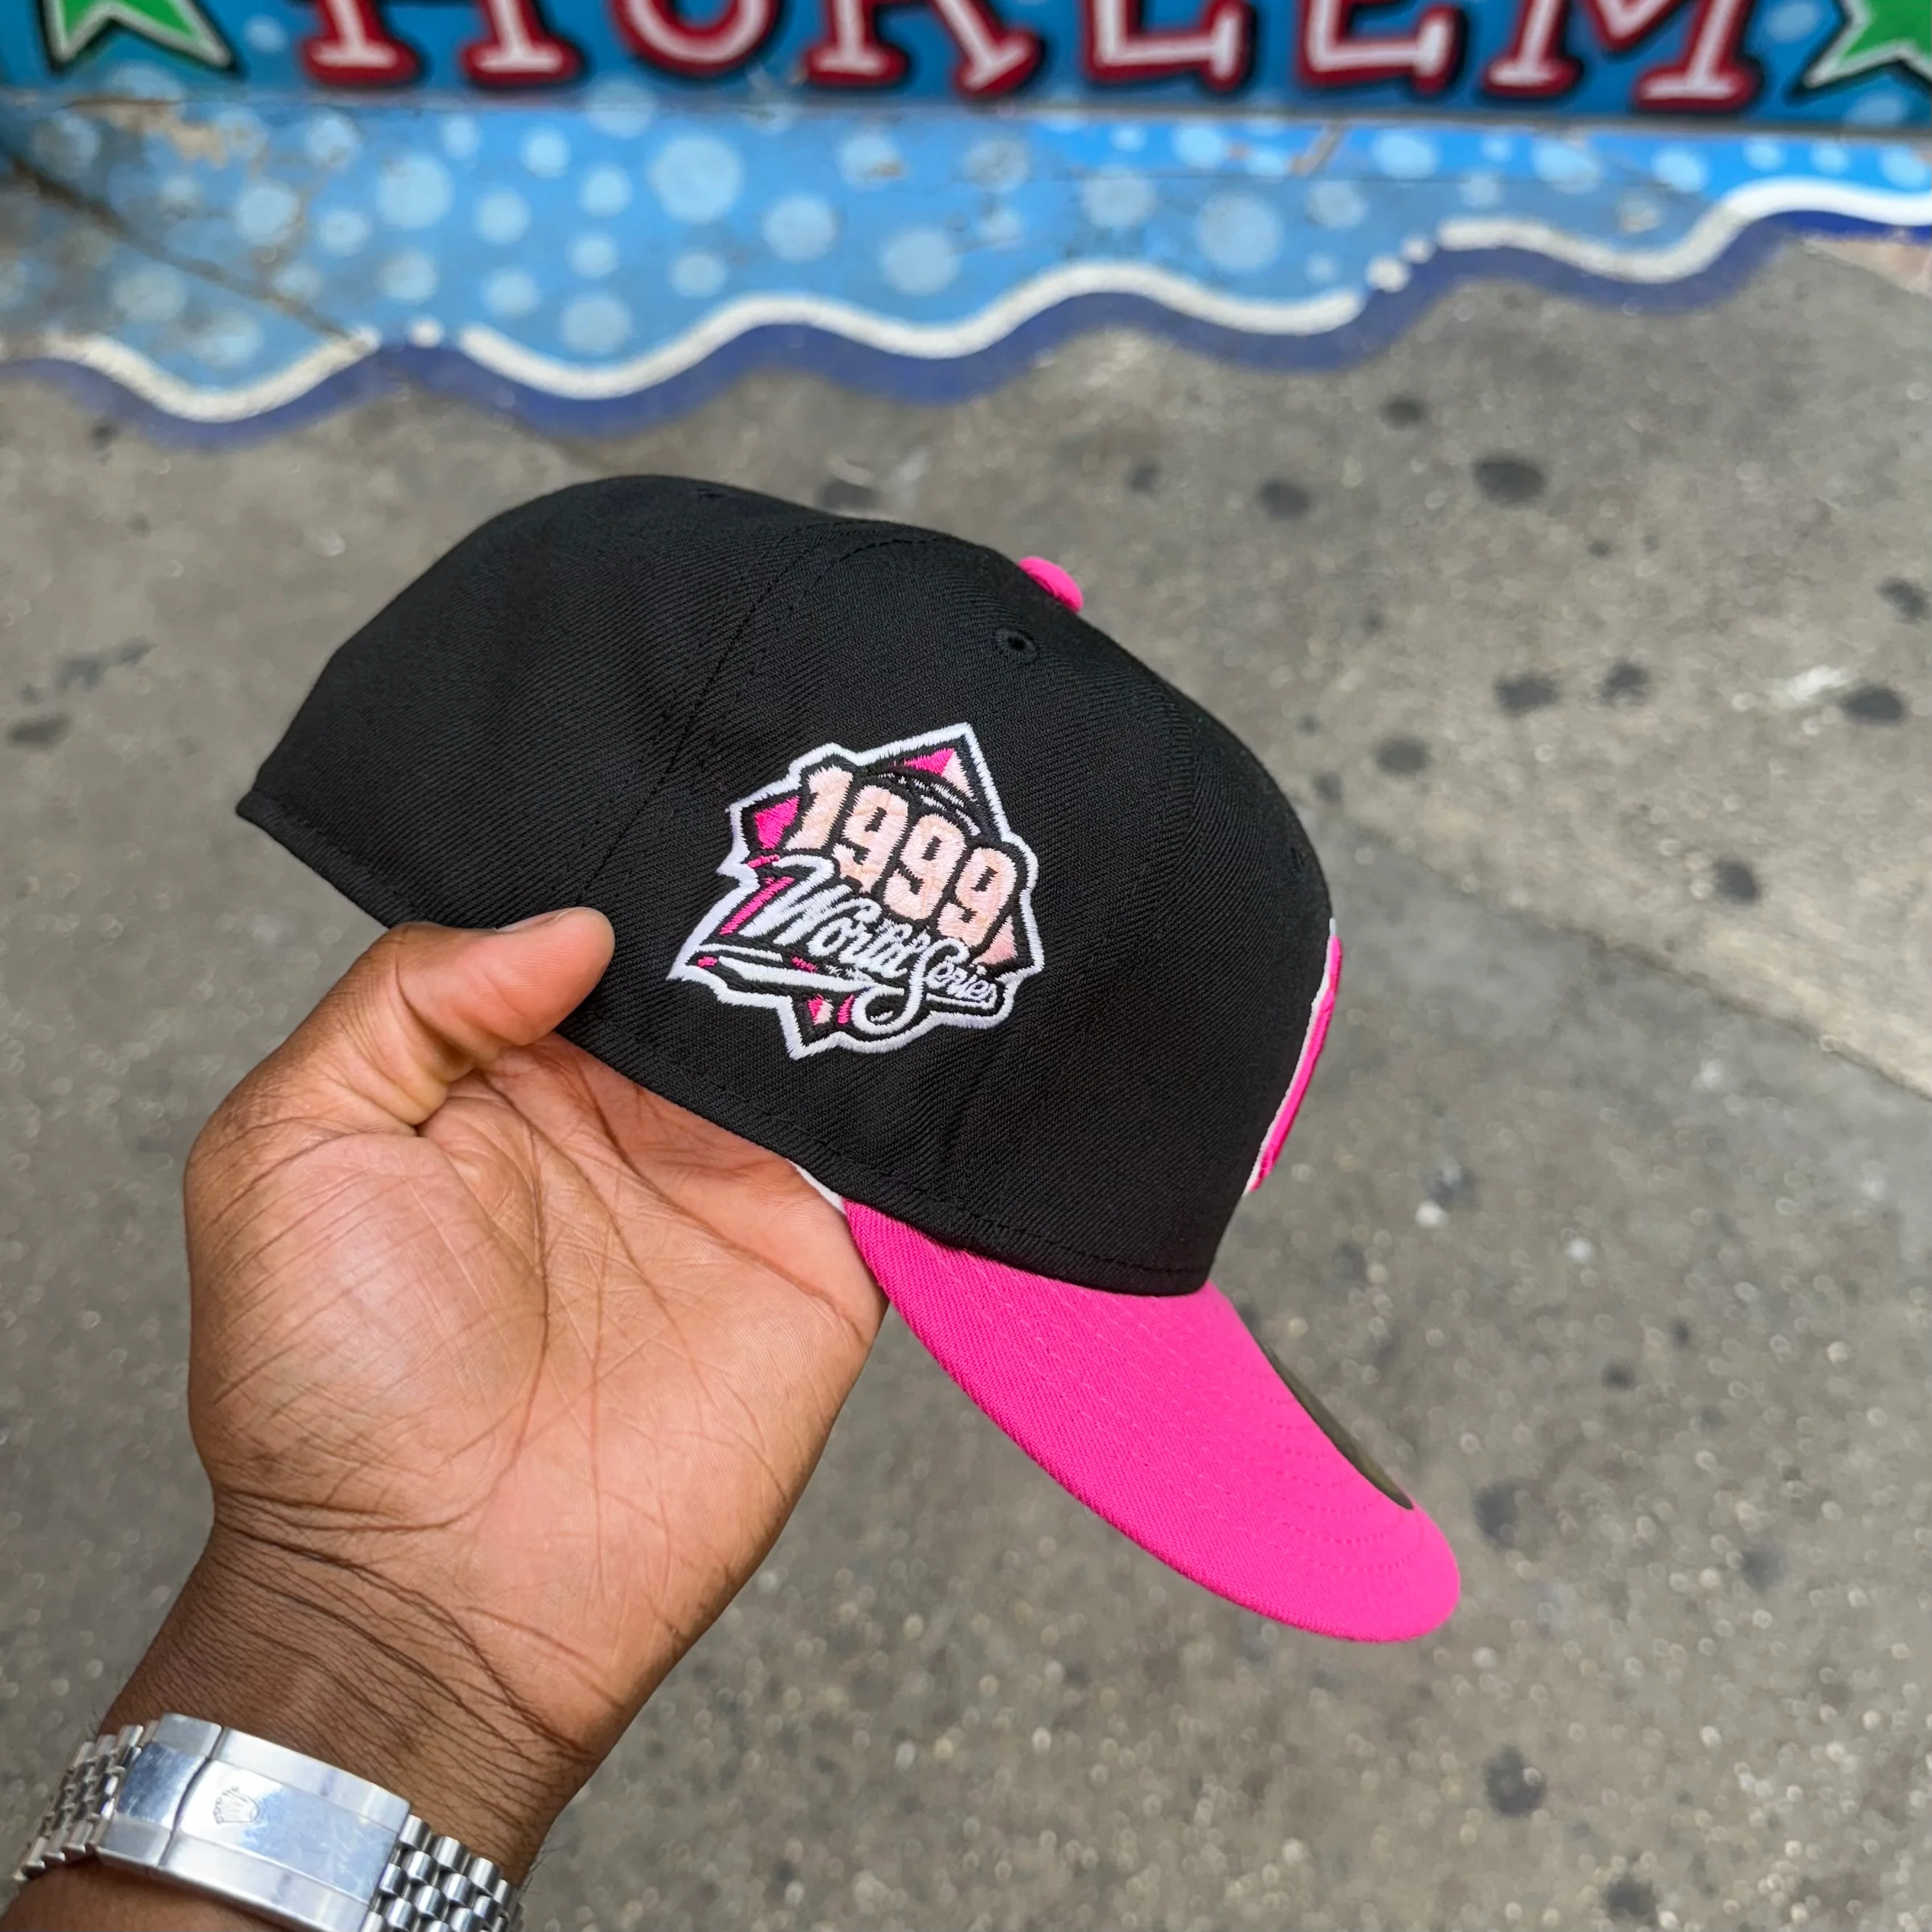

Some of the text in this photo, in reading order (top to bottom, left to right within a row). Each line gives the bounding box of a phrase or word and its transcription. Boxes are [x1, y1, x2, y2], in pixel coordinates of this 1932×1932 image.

[738, 855, 998, 1035] World Series
[784, 765, 1017, 947] 1999
